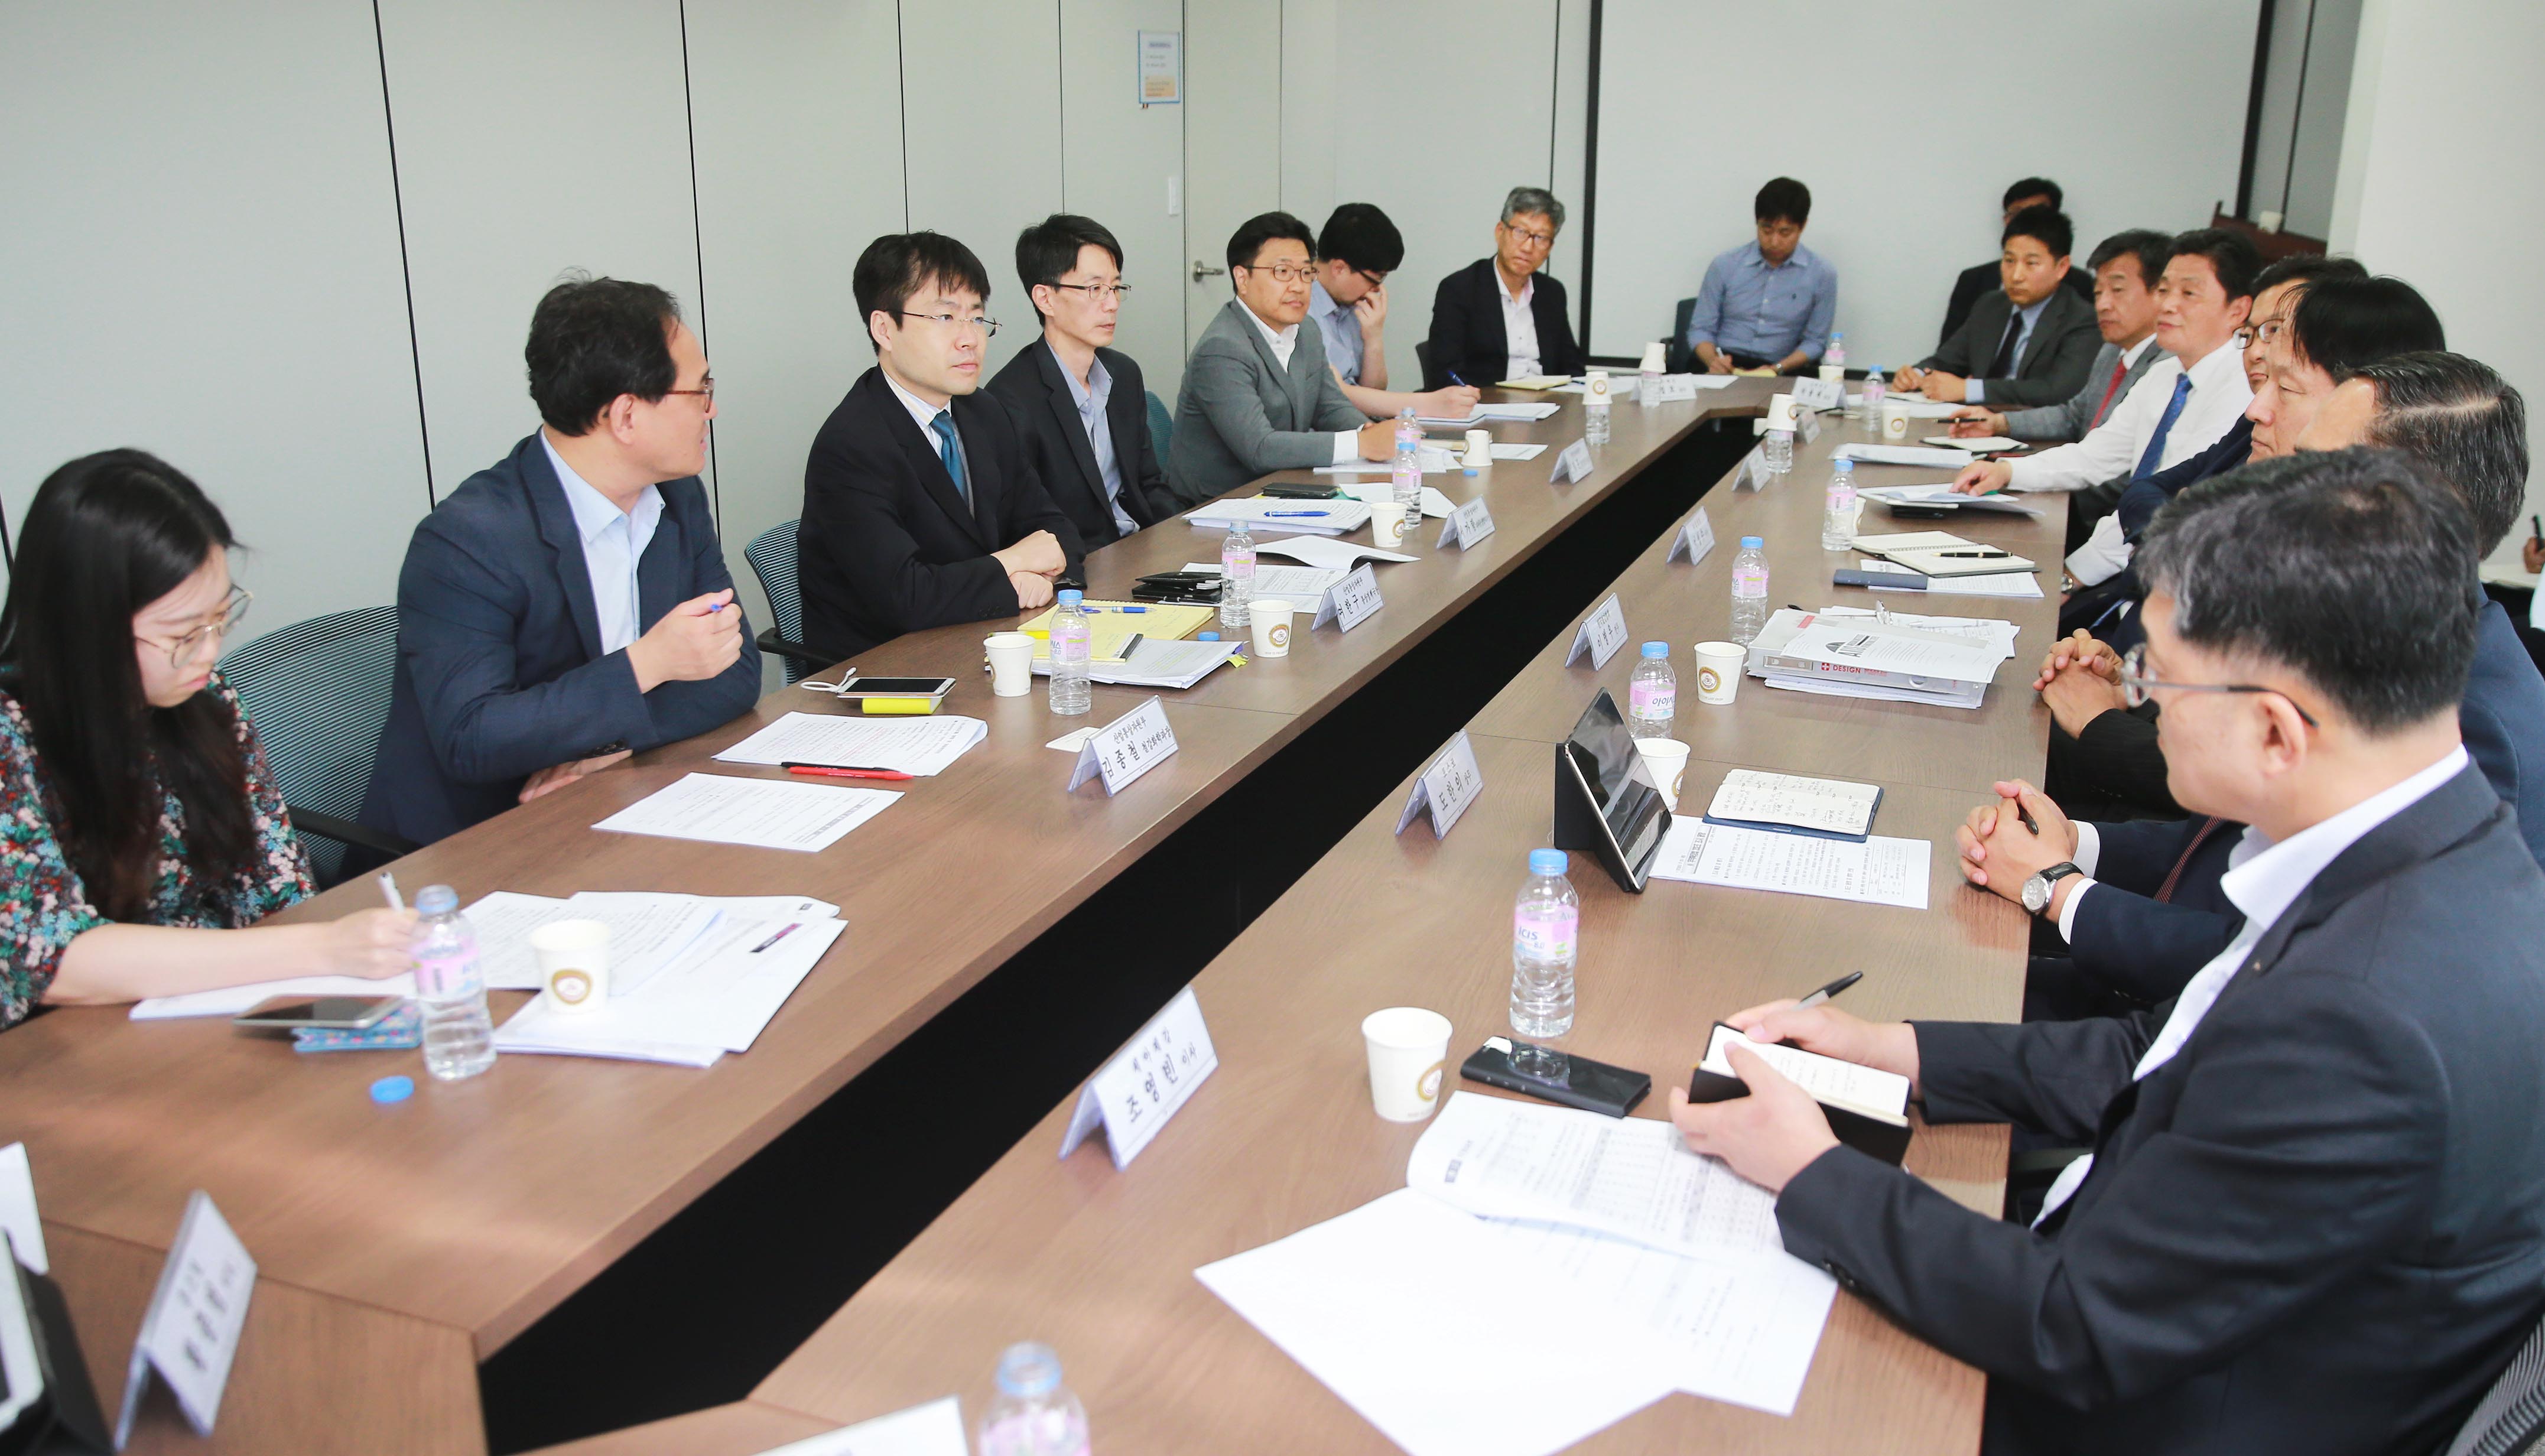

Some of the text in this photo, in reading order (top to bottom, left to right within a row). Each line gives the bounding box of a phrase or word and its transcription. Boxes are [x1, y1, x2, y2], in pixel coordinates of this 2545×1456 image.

[1833, 664, 1861, 674] DESIGN
[1113, 715, 1148, 745] 산업통상자원부
[1102, 725, 1171, 779] 김종철 철강화학과장
[1126, 1042, 1198, 1123] 조영빈 이사
